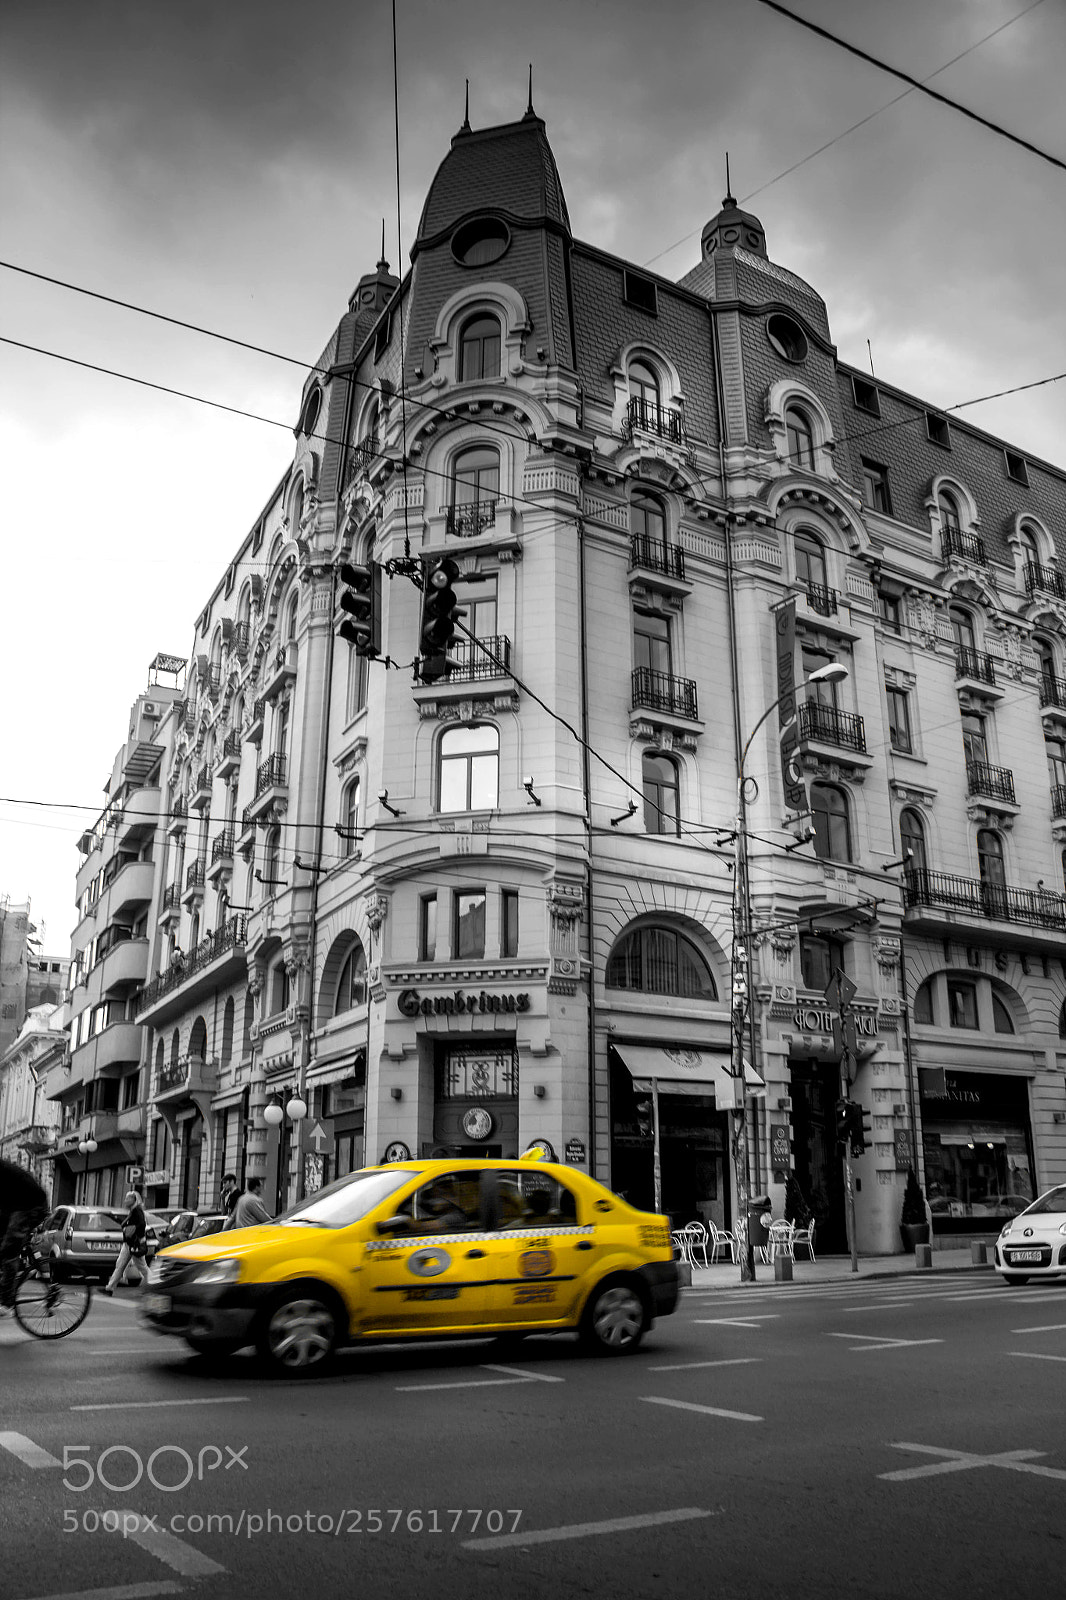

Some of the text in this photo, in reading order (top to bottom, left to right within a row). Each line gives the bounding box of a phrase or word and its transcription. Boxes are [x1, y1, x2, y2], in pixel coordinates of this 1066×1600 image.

[781, 732, 805, 804] HOTEL
[397, 987, 531, 1017] Gambrinus
[794, 1007, 880, 1036] HOTEL MIGIU
[129, 1167, 142, 1183] P
